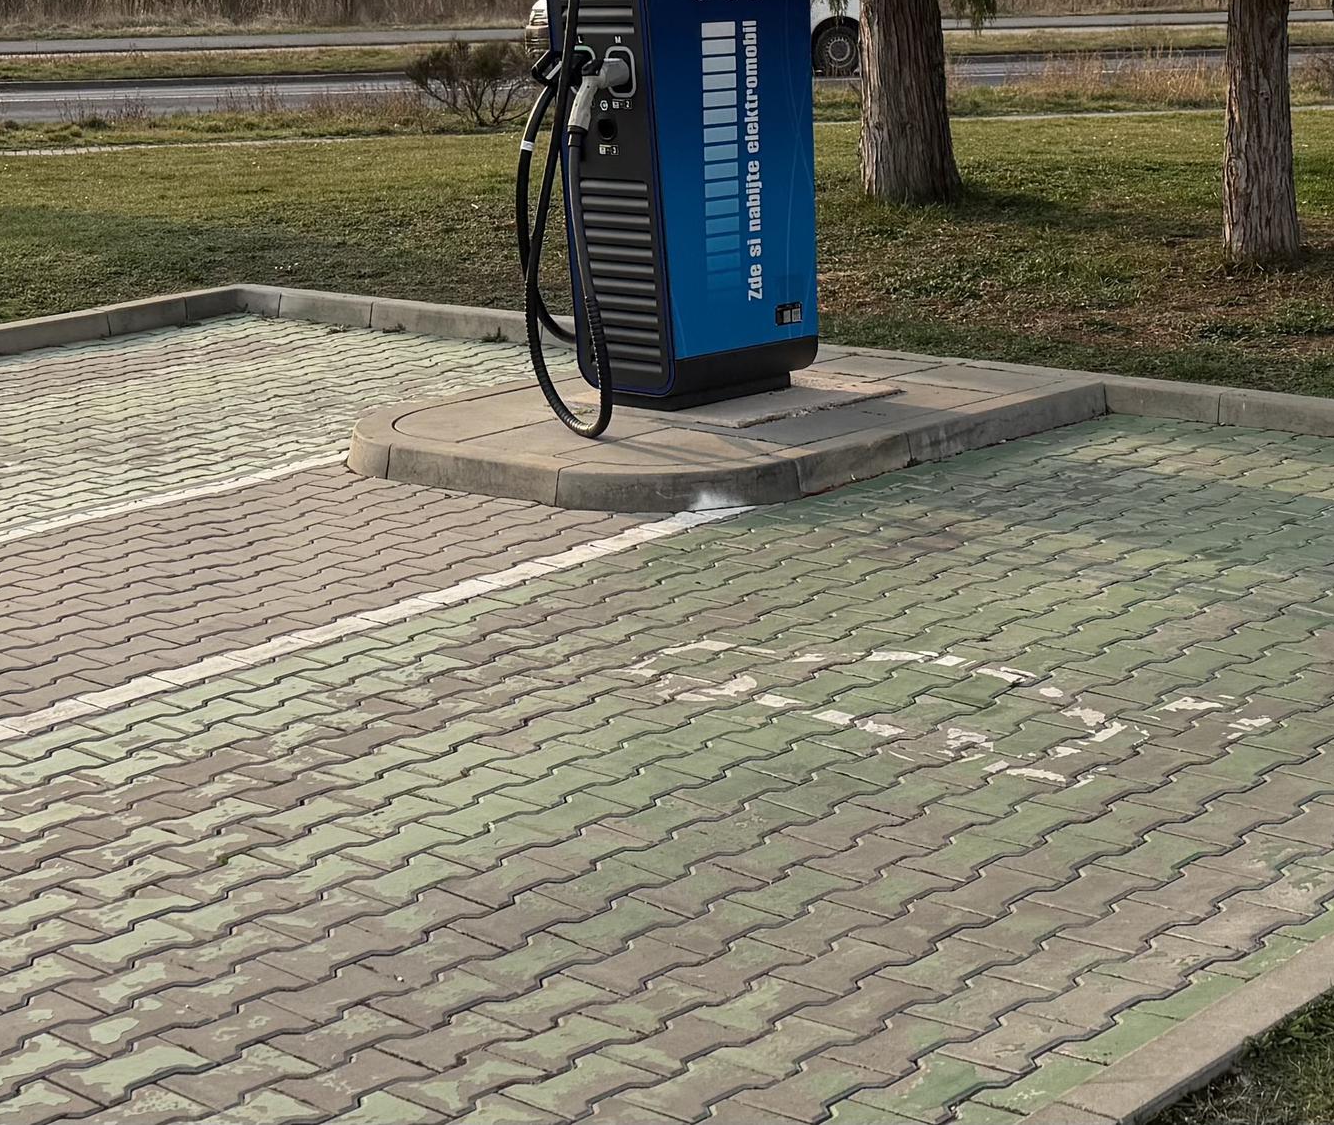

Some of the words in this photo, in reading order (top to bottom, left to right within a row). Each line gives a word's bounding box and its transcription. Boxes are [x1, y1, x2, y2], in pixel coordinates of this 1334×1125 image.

[742, 20, 760, 153] elektromobil
[746, 160, 762, 232] nabijte
[747, 238, 762, 257] si
[748, 263, 763, 302] Zde
